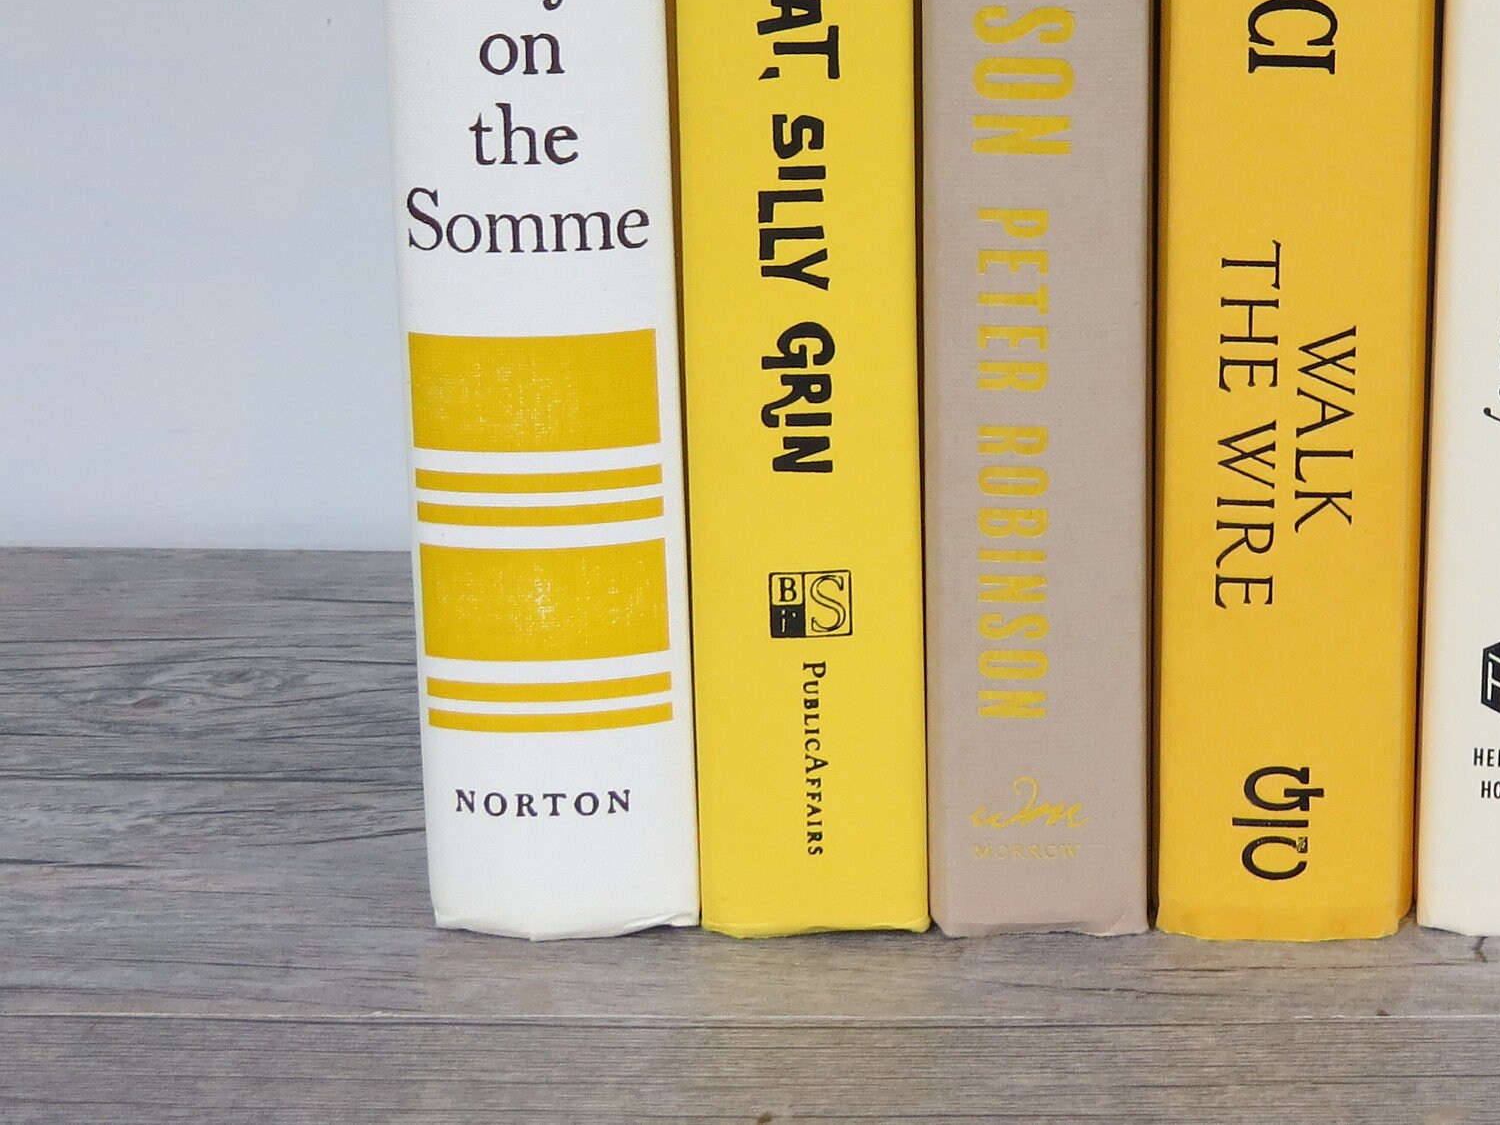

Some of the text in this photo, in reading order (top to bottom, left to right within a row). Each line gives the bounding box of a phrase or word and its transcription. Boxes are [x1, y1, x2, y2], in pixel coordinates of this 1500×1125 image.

[479, 33, 565, 76] on
[468, 102, 579, 166] the
[757, 113, 830, 291] SILLY
[406, 187, 650, 254] Somme
[760, 321, 836, 474] GRIN
[977, 208, 1050, 718] PETER ROBINSON
[1214, 239, 1282, 609] THE WIRE
[1294, 325, 1357, 533] WALK
[455, 789, 631, 817] NORTON
